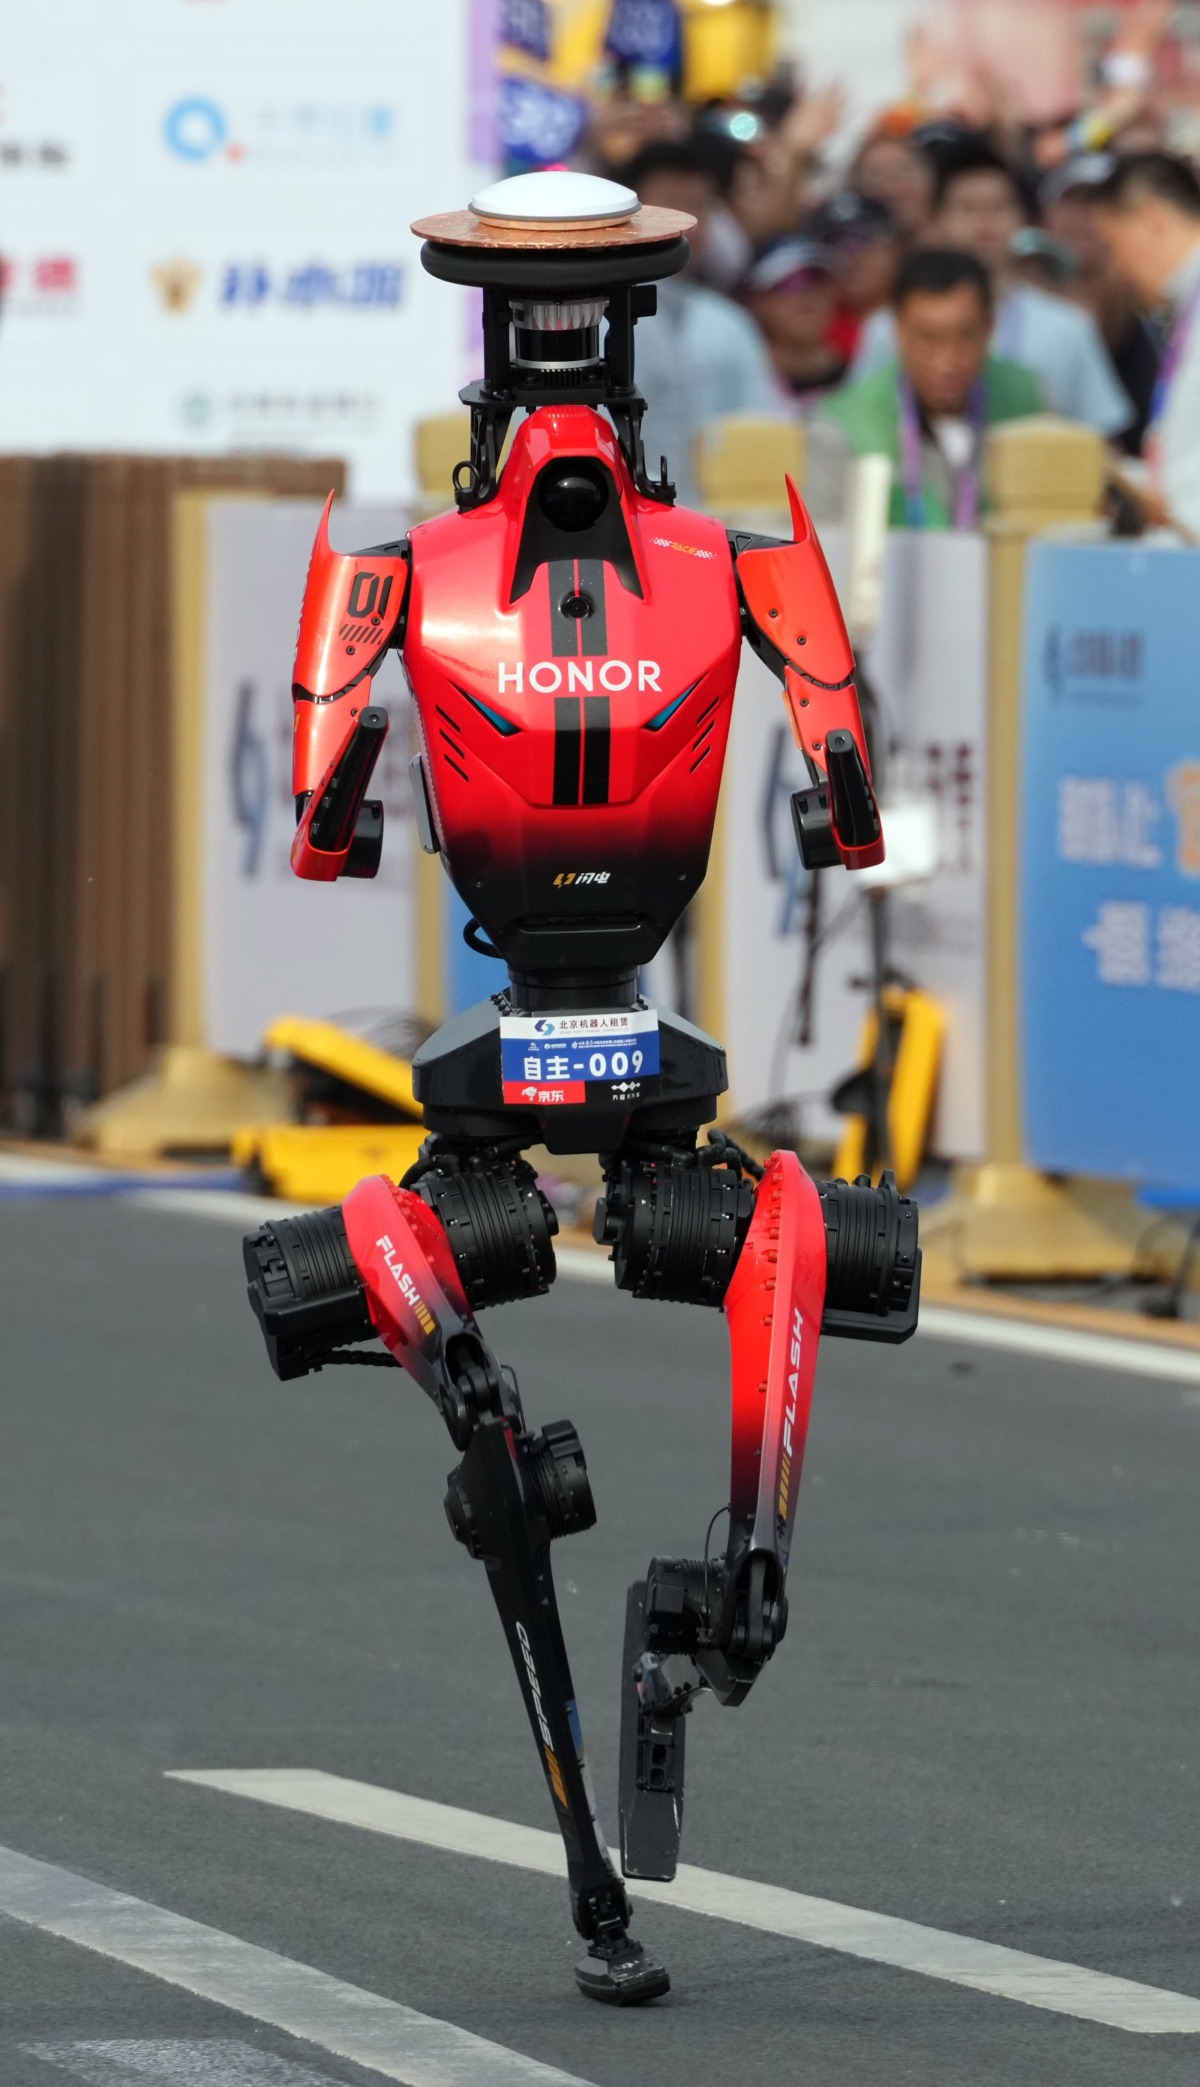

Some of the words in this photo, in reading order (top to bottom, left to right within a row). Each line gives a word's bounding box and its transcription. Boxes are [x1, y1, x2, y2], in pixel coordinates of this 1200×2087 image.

[671, 542, 698, 555] RACE
[347, 571, 393, 620] 01
[498, 660, 662, 693] HONOR
[575, 871, 611, 885] 闪电
[560, 1016, 629, 1030] 北京机器人租赁
[523, 1050, 643, 1081] 自主-009
[538, 1090, 564, 1102] 京东
[375, 1234, 420, 1306] FLASH
[783, 1307, 804, 1457] FLASH
[515, 1620, 554, 1752] SPEED
